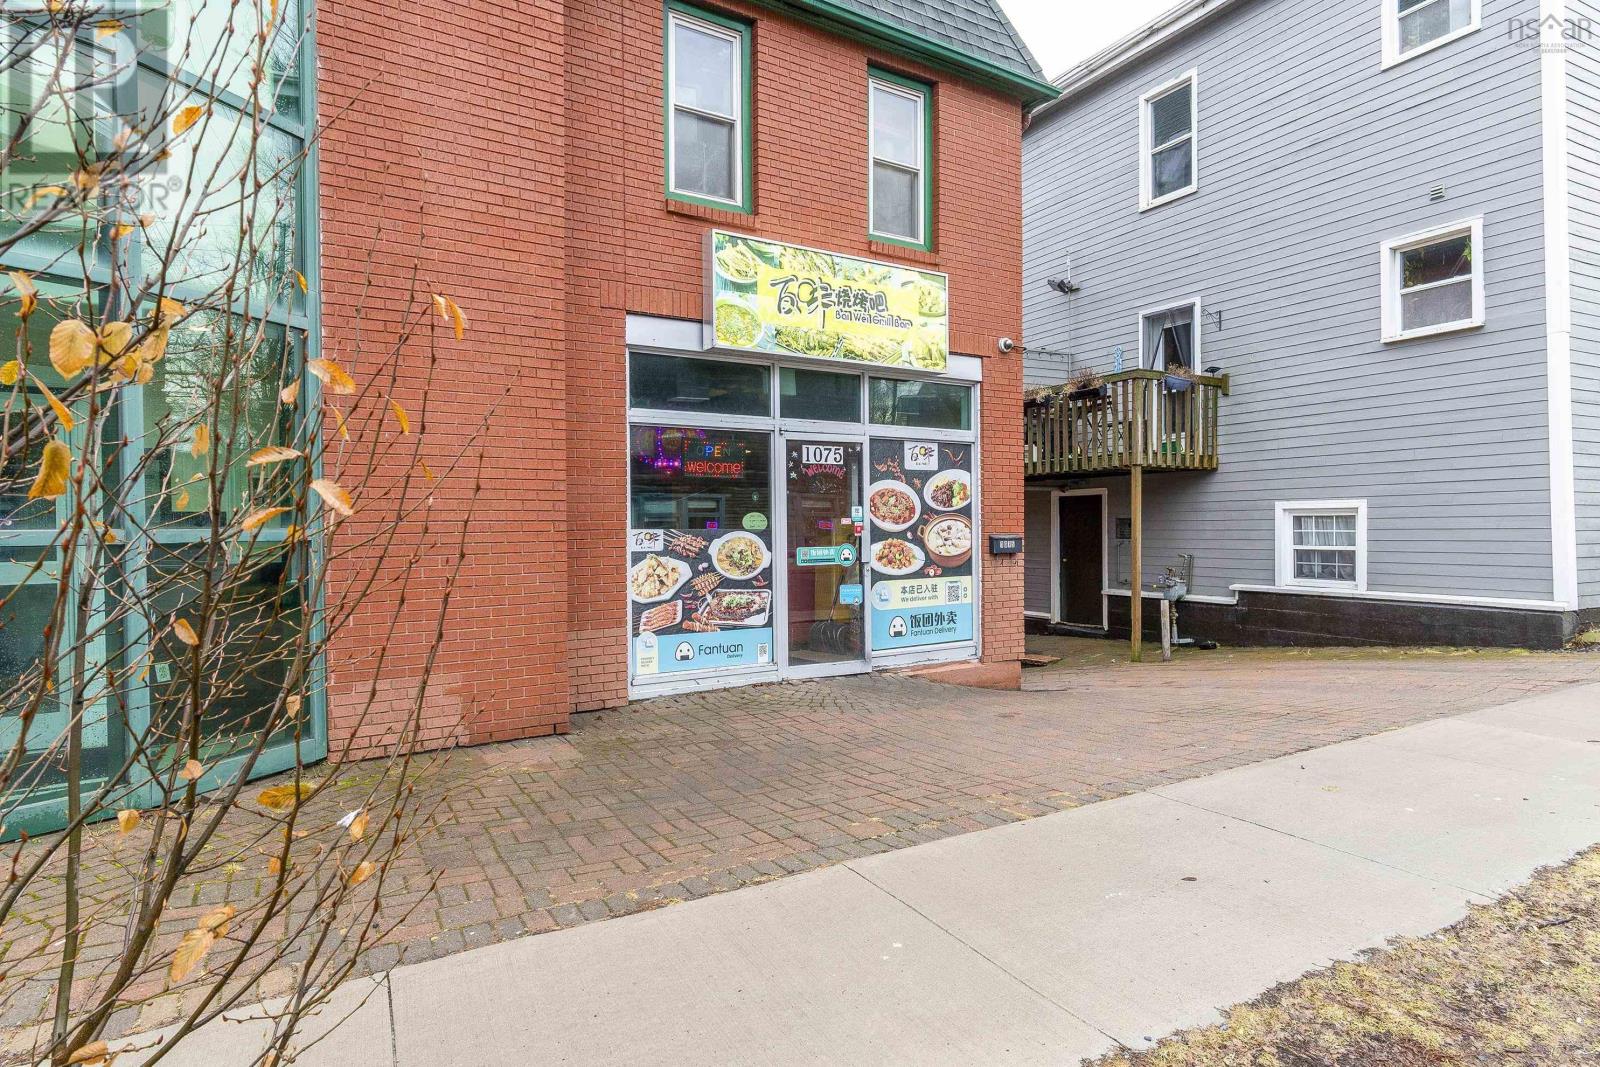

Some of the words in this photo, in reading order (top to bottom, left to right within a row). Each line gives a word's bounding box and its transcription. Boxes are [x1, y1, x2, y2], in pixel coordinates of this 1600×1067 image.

[853, 311, 871, 324] Wei
[872, 314, 893, 327] Grill
[805, 446, 842, 463] 1075
[687, 461, 741, 473] welcome
[901, 584, 938, 594] 本店已入驻
[910, 611, 958, 628] 饭团外卖
[910, 629, 934, 637] Fantuan
[935, 626, 957, 635] Delivery
[698, 643, 743, 656] Fantuan
